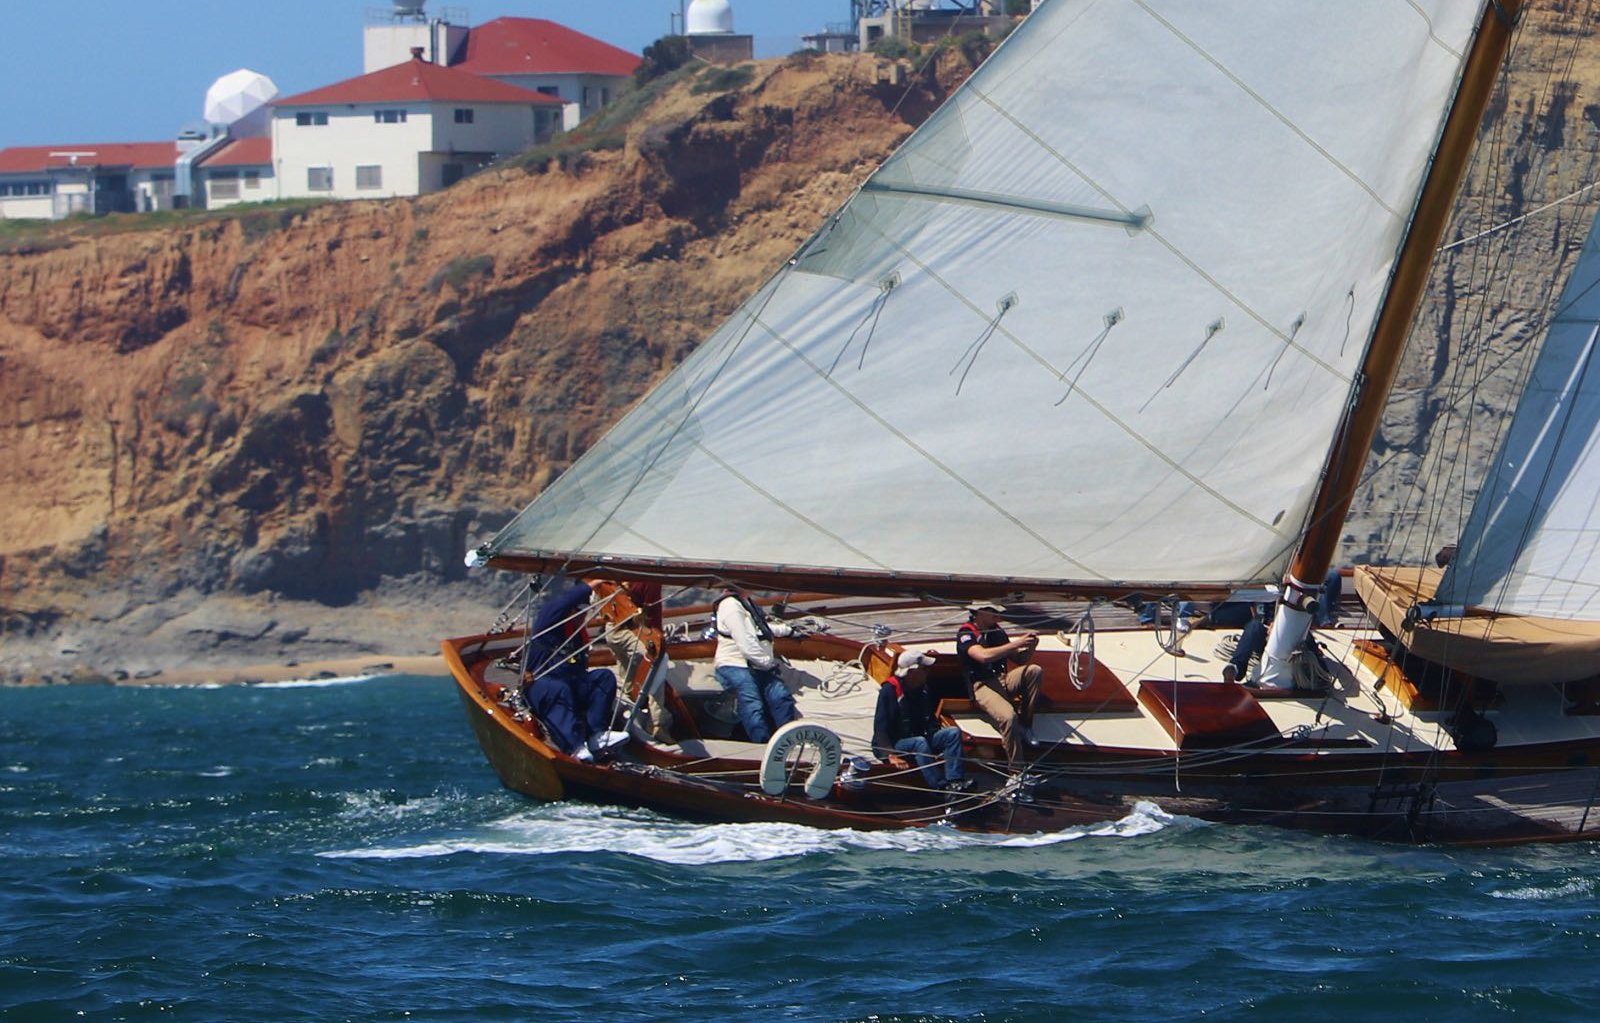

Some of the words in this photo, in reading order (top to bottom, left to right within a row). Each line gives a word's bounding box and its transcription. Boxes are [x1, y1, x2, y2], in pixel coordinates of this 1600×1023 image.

[773, 738, 795, 762] ROSE
[796, 730, 811, 741] OF
[812, 730, 836, 767] SHARON
